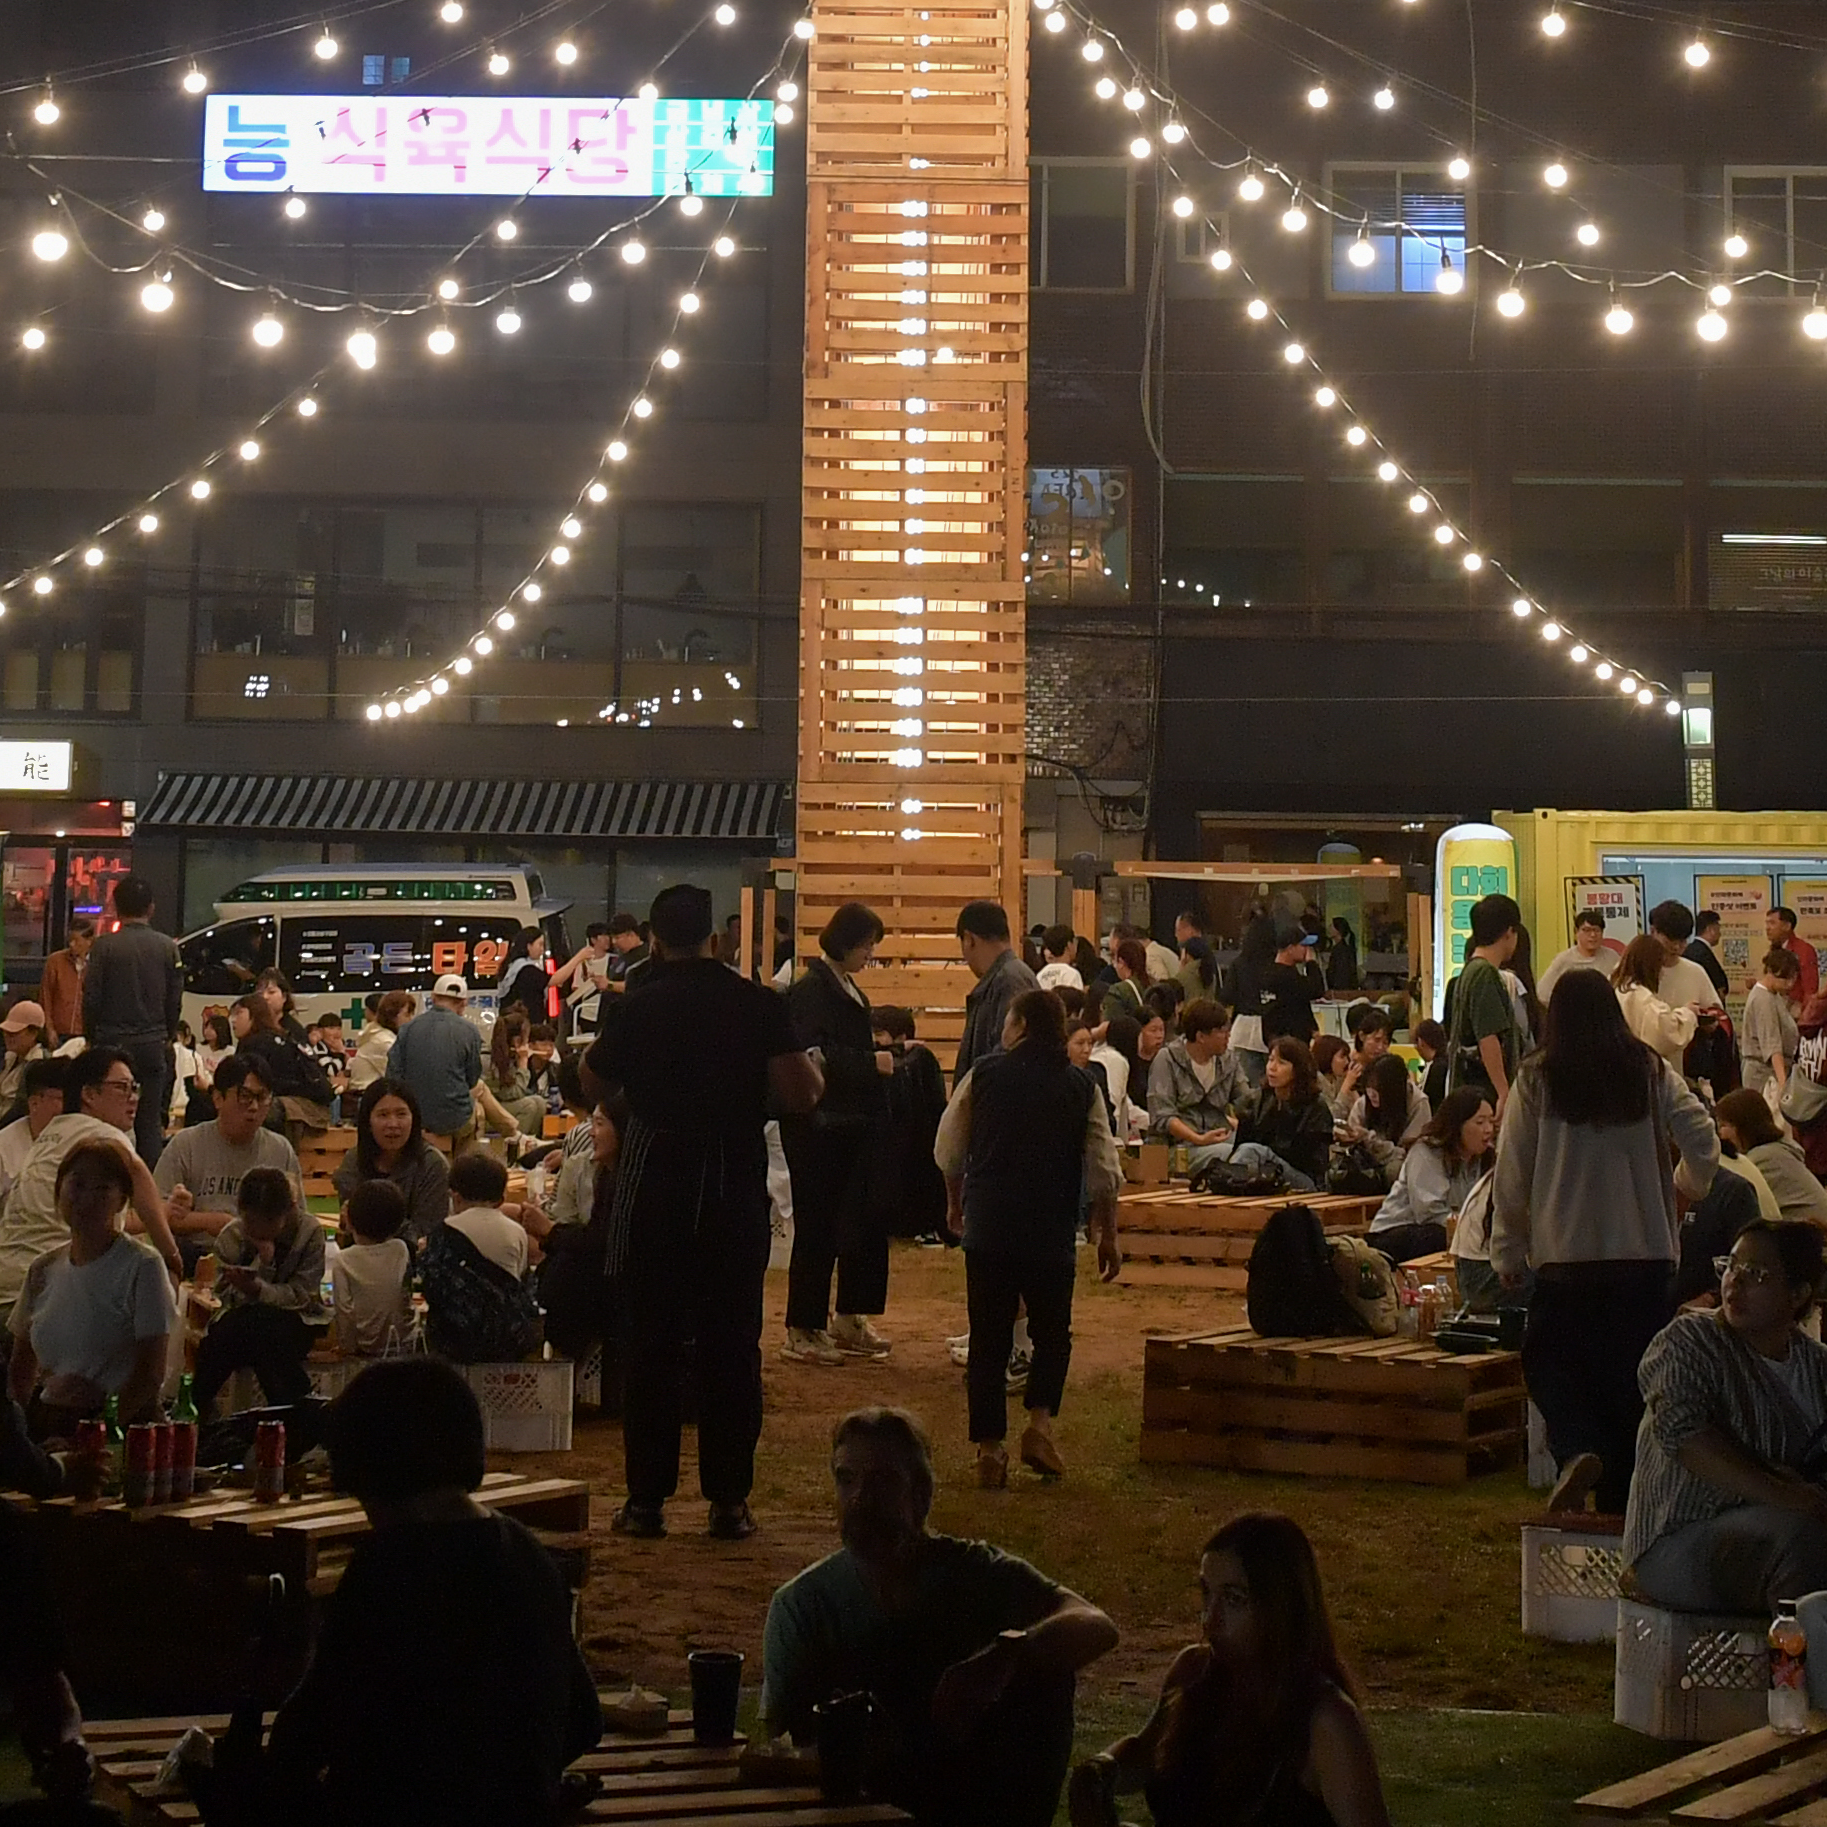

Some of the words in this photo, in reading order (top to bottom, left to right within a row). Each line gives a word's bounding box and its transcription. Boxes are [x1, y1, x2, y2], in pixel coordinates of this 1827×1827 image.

[222, 104, 291, 183] 능
[321, 106, 637, 186] 식육식당
[21, 751, 50, 782] 能
[1451, 865, 1508, 896] 다회
[342, 941, 414, 975] 골든
